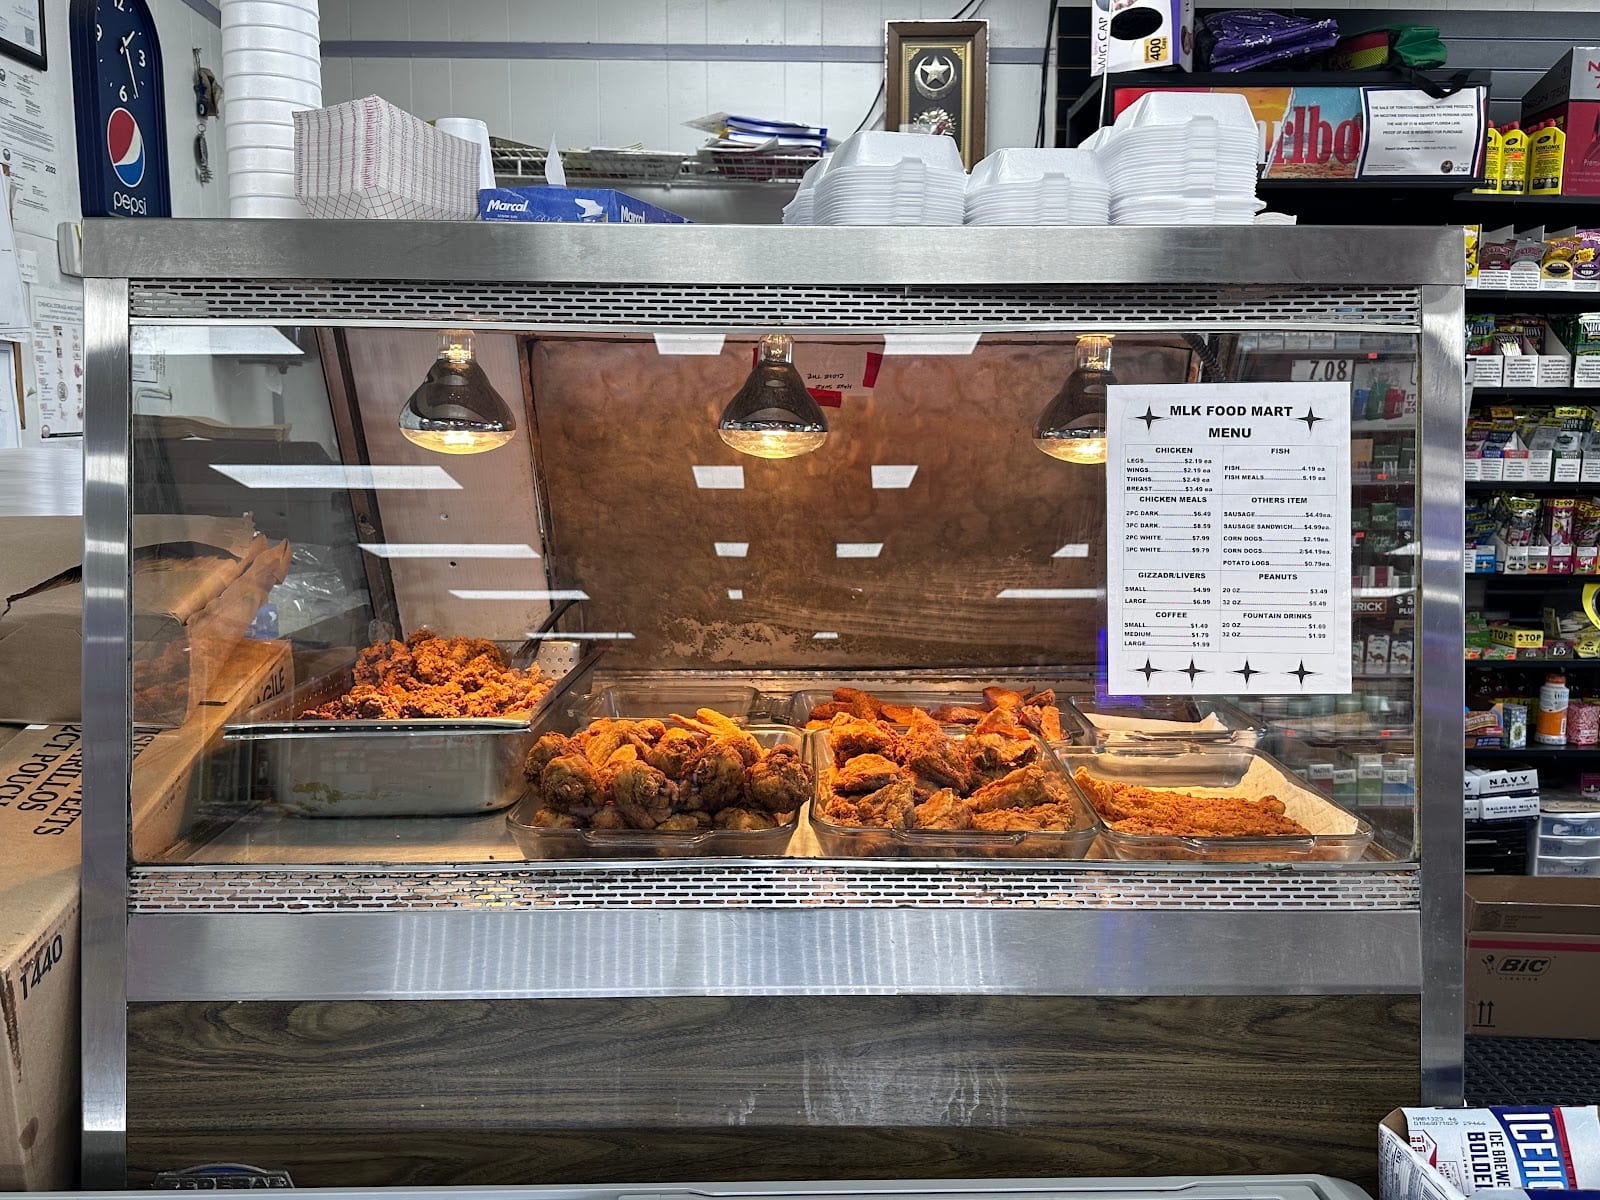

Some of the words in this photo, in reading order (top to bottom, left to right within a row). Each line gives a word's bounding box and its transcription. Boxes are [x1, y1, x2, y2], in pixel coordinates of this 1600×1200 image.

[1097, 17, 1107, 40] CAP
[1150, 38, 1162, 60] 400
[138, 50, 146, 67] 3
[119, 86, 128, 102] 6
[113, 190, 147, 216] pepsi
[486, 200, 529, 212] Marcal
[620, 205, 646, 224] Marcal
[1310, 360, 1347, 380] 7.08
[1170, 406, 1202, 416] MLK
[1206, 406, 1247, 416] FOOD
[1251, 406, 1293, 417] MART
[1208, 428, 1252, 438] MENU
[1494, 630, 1509, 641] TOP
[1489, 775, 1528, 786] NAVY
[20, 934, 62, 1000] 1440
[1488, 1131, 1504, 1148] ICE
